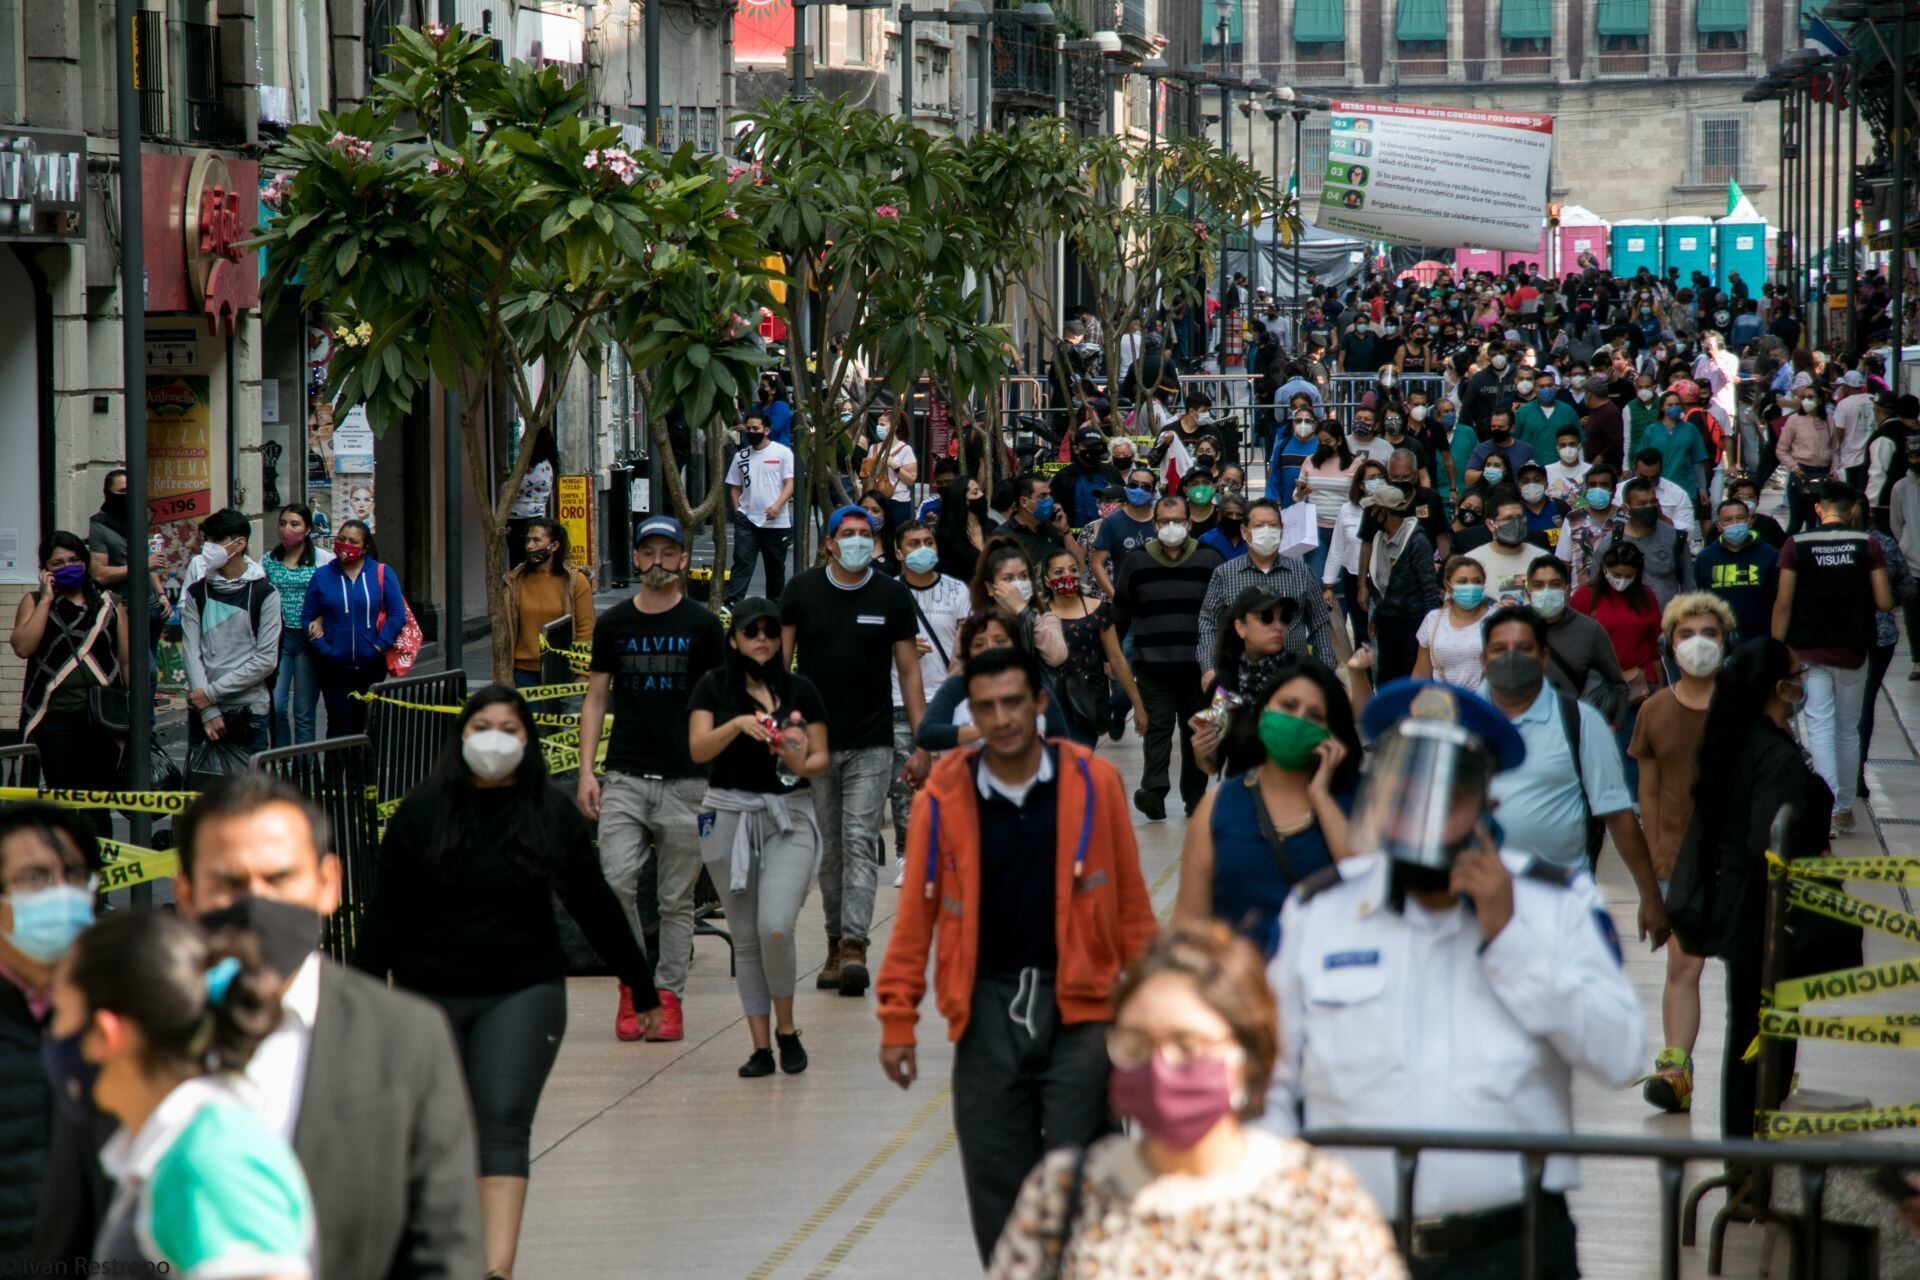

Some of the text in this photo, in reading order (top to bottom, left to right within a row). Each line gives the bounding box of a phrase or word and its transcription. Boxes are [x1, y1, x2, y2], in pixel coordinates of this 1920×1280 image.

[1446, 110, 1486, 120] CONTAGIO
[1505, 115, 1542, 126] COVID-19
[1334, 139, 1347, 149] 02
[1476, 132, 1514, 143] permanece
[1523, 139, 1538, 147] casa
[1378, 158, 1396, 166] salud
[1465, 153, 1493, 163] contacto
[1330, 166, 1344, 177] 03
[1501, 168, 1522, 178] centro
[1376, 170, 1383, 178] Si
[1391, 173, 1415, 183] prueba
[1451, 183, 1480, 194] recibirás
[1480, 187, 1501, 197] apoyo
[1326, 191, 1340, 200] 04
[1374, 181, 1413, 192] alimentario
[1418, 187, 1454, 198] económico
[1454, 193, 1470, 201] para
[1492, 199, 1517, 208] quedes
[1371, 199, 1400, 209] Brigadas
[1400, 204, 1442, 217] informativas
[1480, 216, 1496, 225] para
[1496, 220, 1530, 230] orientarte
[152, 428, 206, 444] IZZA
[153, 460, 209, 477] PREMA
[561, 506, 585, 519] ORO
[1811, 544, 1856, 554] PRESENTACIÓN
[1815, 554, 1854, 566] VISUAL
[614, 635, 691, 654] CALVIN
